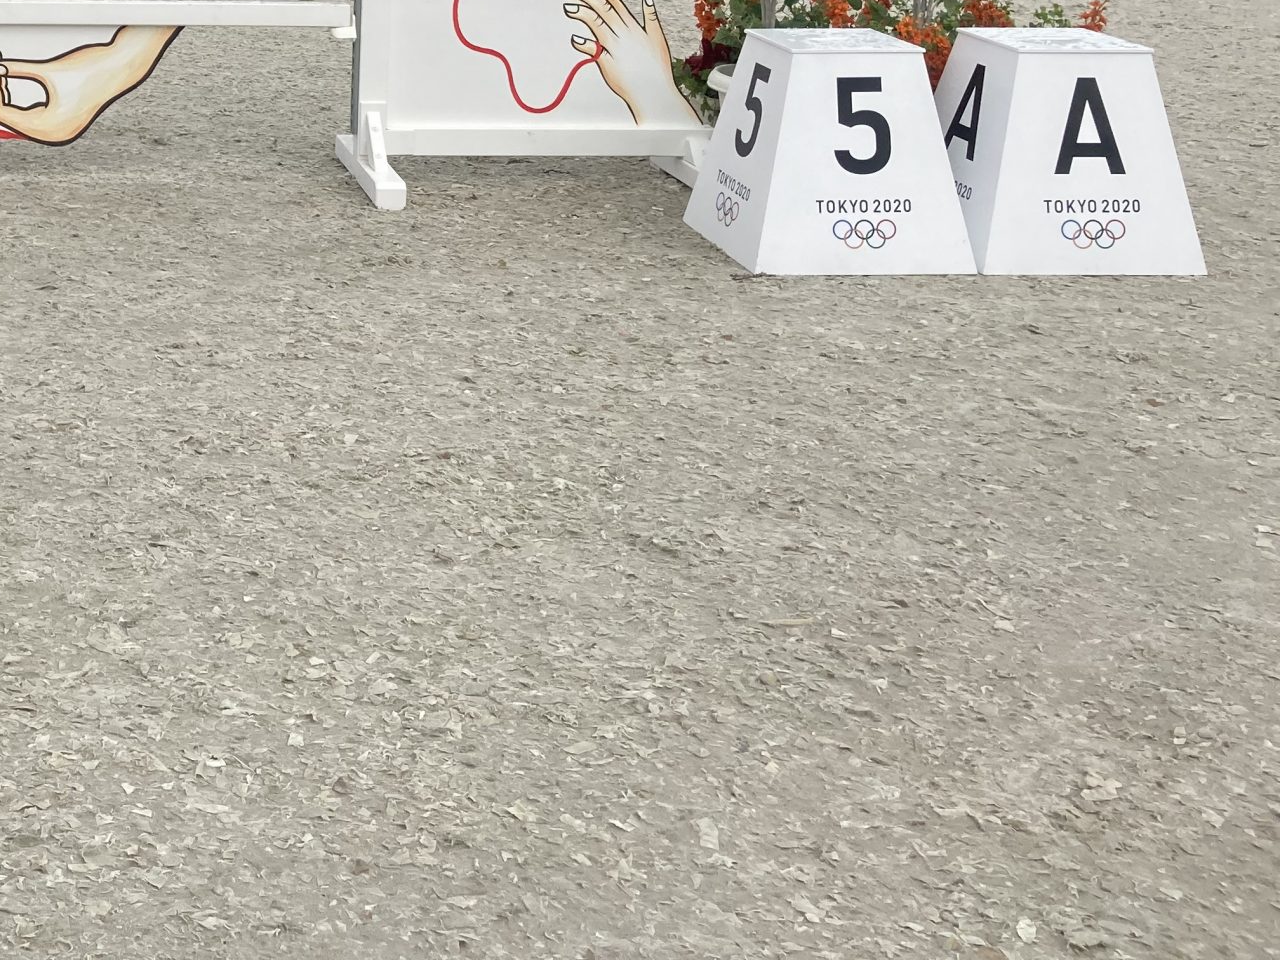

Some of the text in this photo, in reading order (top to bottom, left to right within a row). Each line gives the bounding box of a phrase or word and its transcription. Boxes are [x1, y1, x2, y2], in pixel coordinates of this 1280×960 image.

[734, 62, 772, 158] 5
[834, 76, 892, 175] 5
[944, 63, 986, 162] A
[1054, 77, 1127, 175] A
[717, 169, 751, 202] TOKYO 2020
[815, 199, 912, 214] TOKYO 2020
[1043, 199, 1141, 214] TOKYO 2020
